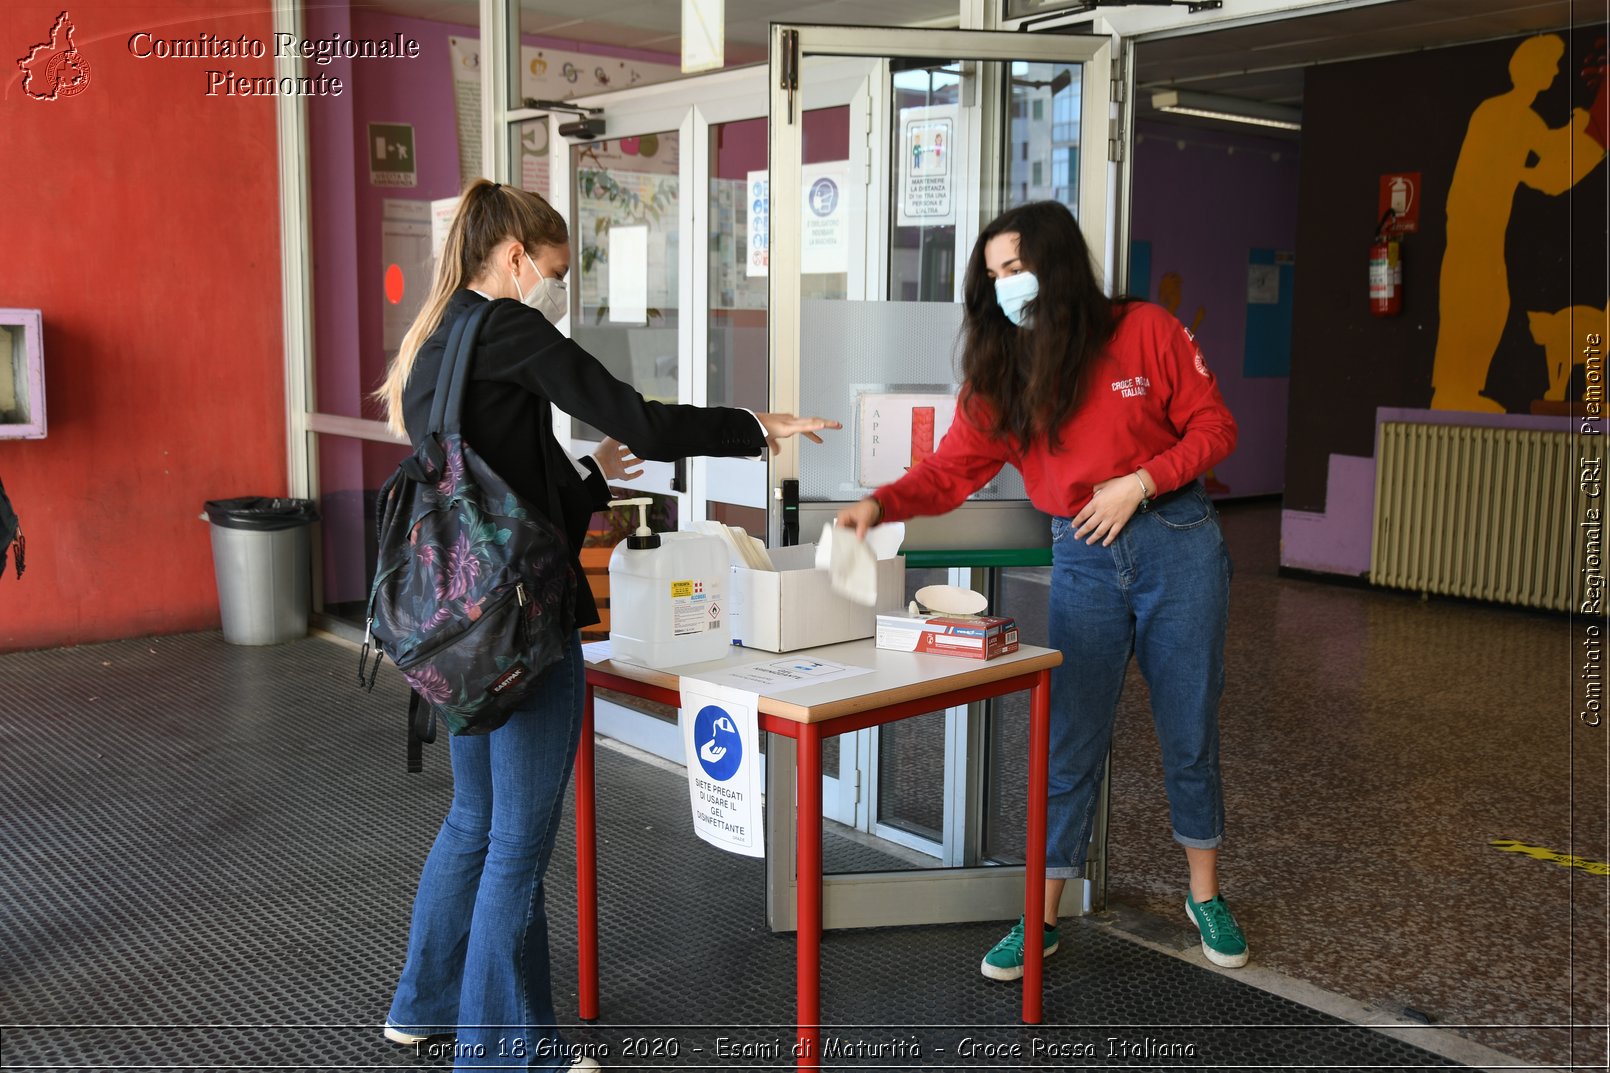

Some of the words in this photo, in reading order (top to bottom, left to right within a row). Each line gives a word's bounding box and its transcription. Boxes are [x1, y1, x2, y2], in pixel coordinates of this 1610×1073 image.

[1112, 379, 1133, 392] CROCE
[872, 409, 880, 457] APRI
[494, 669, 522, 692] EASTPAK
[695, 778, 711, 792] SIETE
[713, 785, 743, 801] PREGATI
[699, 791, 705, 800] DI
[707, 794, 728, 808] USARE
[730, 802, 736, 811] IL
[697, 810, 745, 835] DISINFETTANTE
[711, 806, 723, 818] GEL
